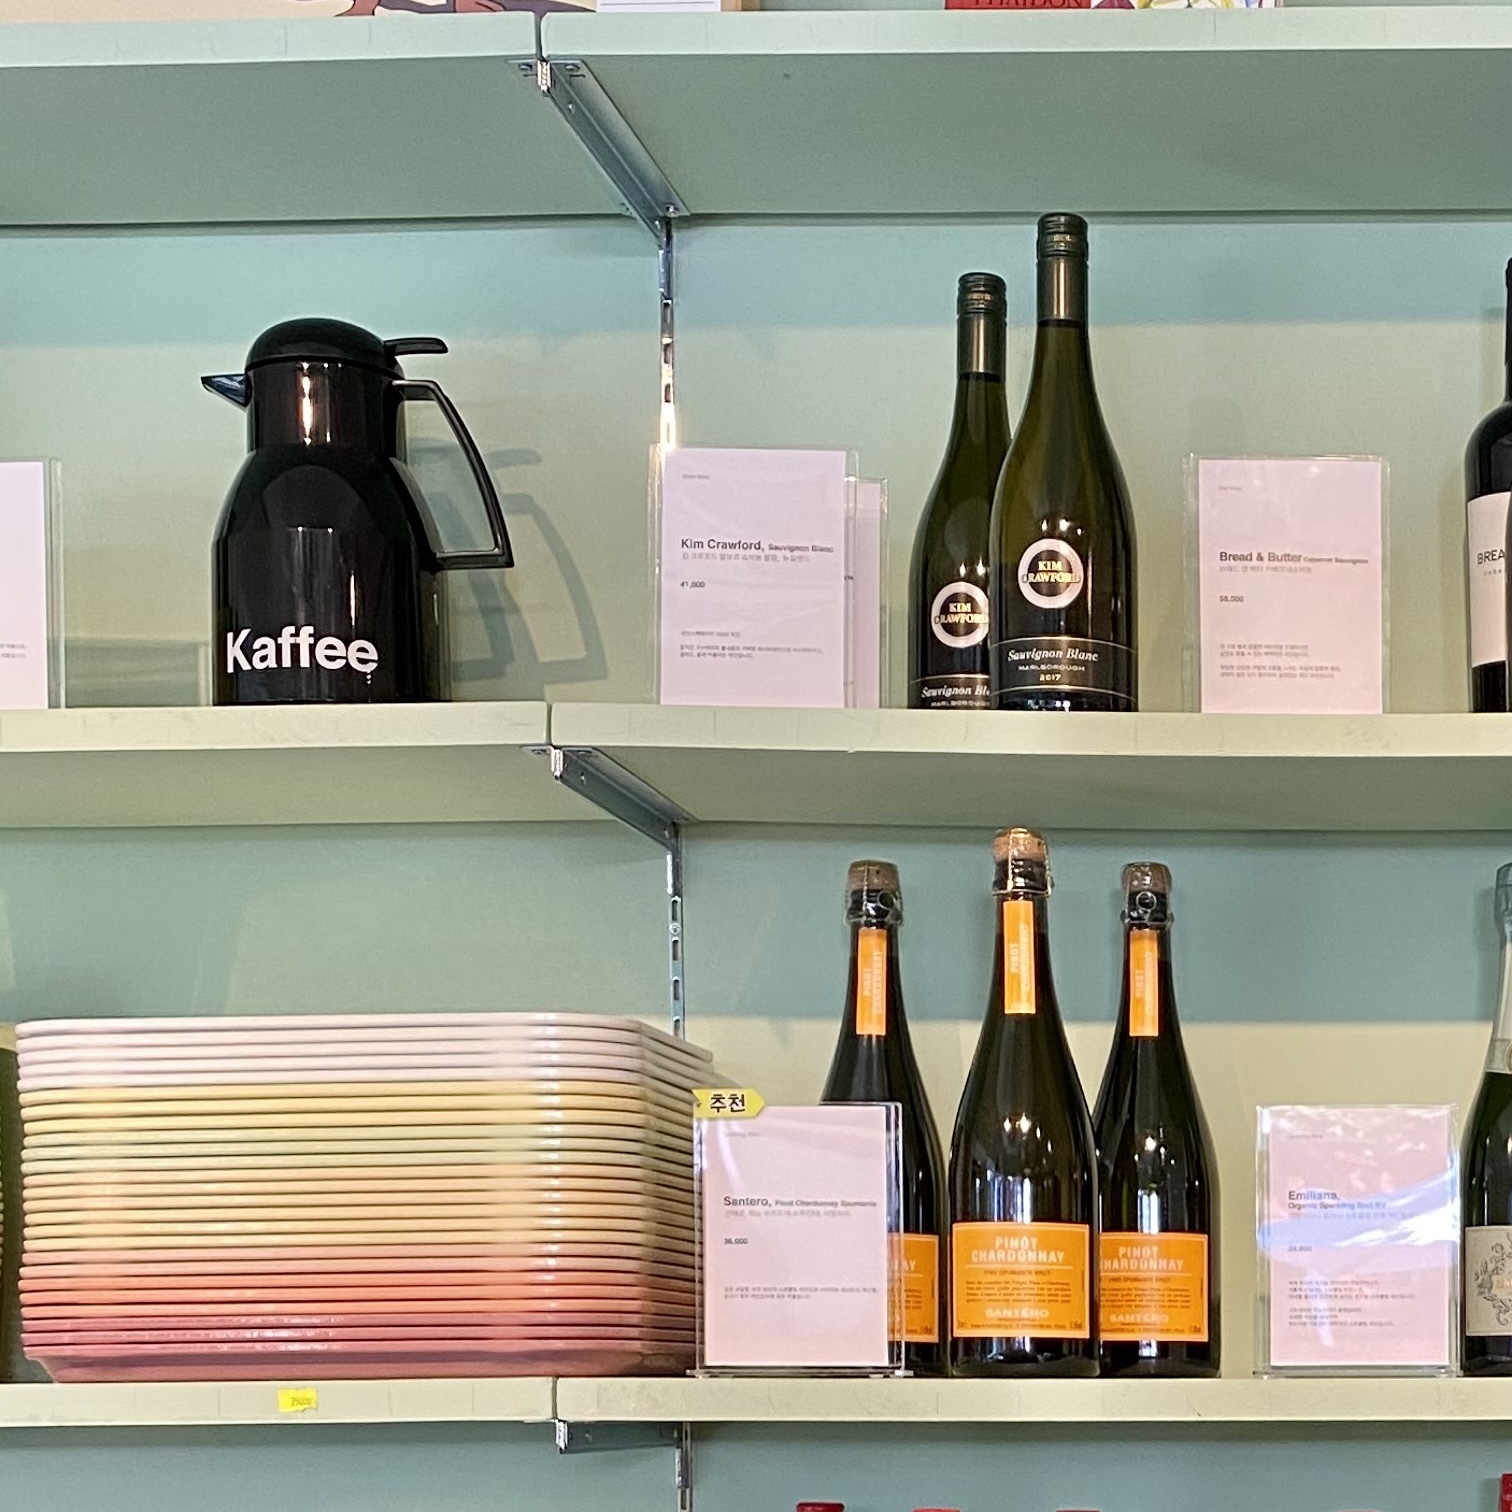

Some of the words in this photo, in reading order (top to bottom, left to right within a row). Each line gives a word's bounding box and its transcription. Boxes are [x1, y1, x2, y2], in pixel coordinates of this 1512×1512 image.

[681, 539, 704, 550] Kim
[707, 539, 765, 553] Crawford,
[1219, 551, 1253, 562] Bread
[1256, 551, 1264, 562] &
[1268, 551, 1302, 562] Butter
[1038, 561, 1062, 571] KIM
[1022, 572, 1081, 583] CRAWFORD
[949, 603, 972, 613] KIM
[226, 626, 379, 674] Kaffee
[1008, 649, 1063, 661] Sauvignon
[1066, 649, 1099, 661] Blanc
[921, 685, 970, 698] Sauvignon
[710, 1094, 745, 1113] 추천
[724, 1196, 772, 1207] Santero,
[996, 1236, 1038, 1249] PINOT
[971, 1250, 1065, 1263] CHARDONNAY
[1118, 1246, 1159, 1259] PINOT
